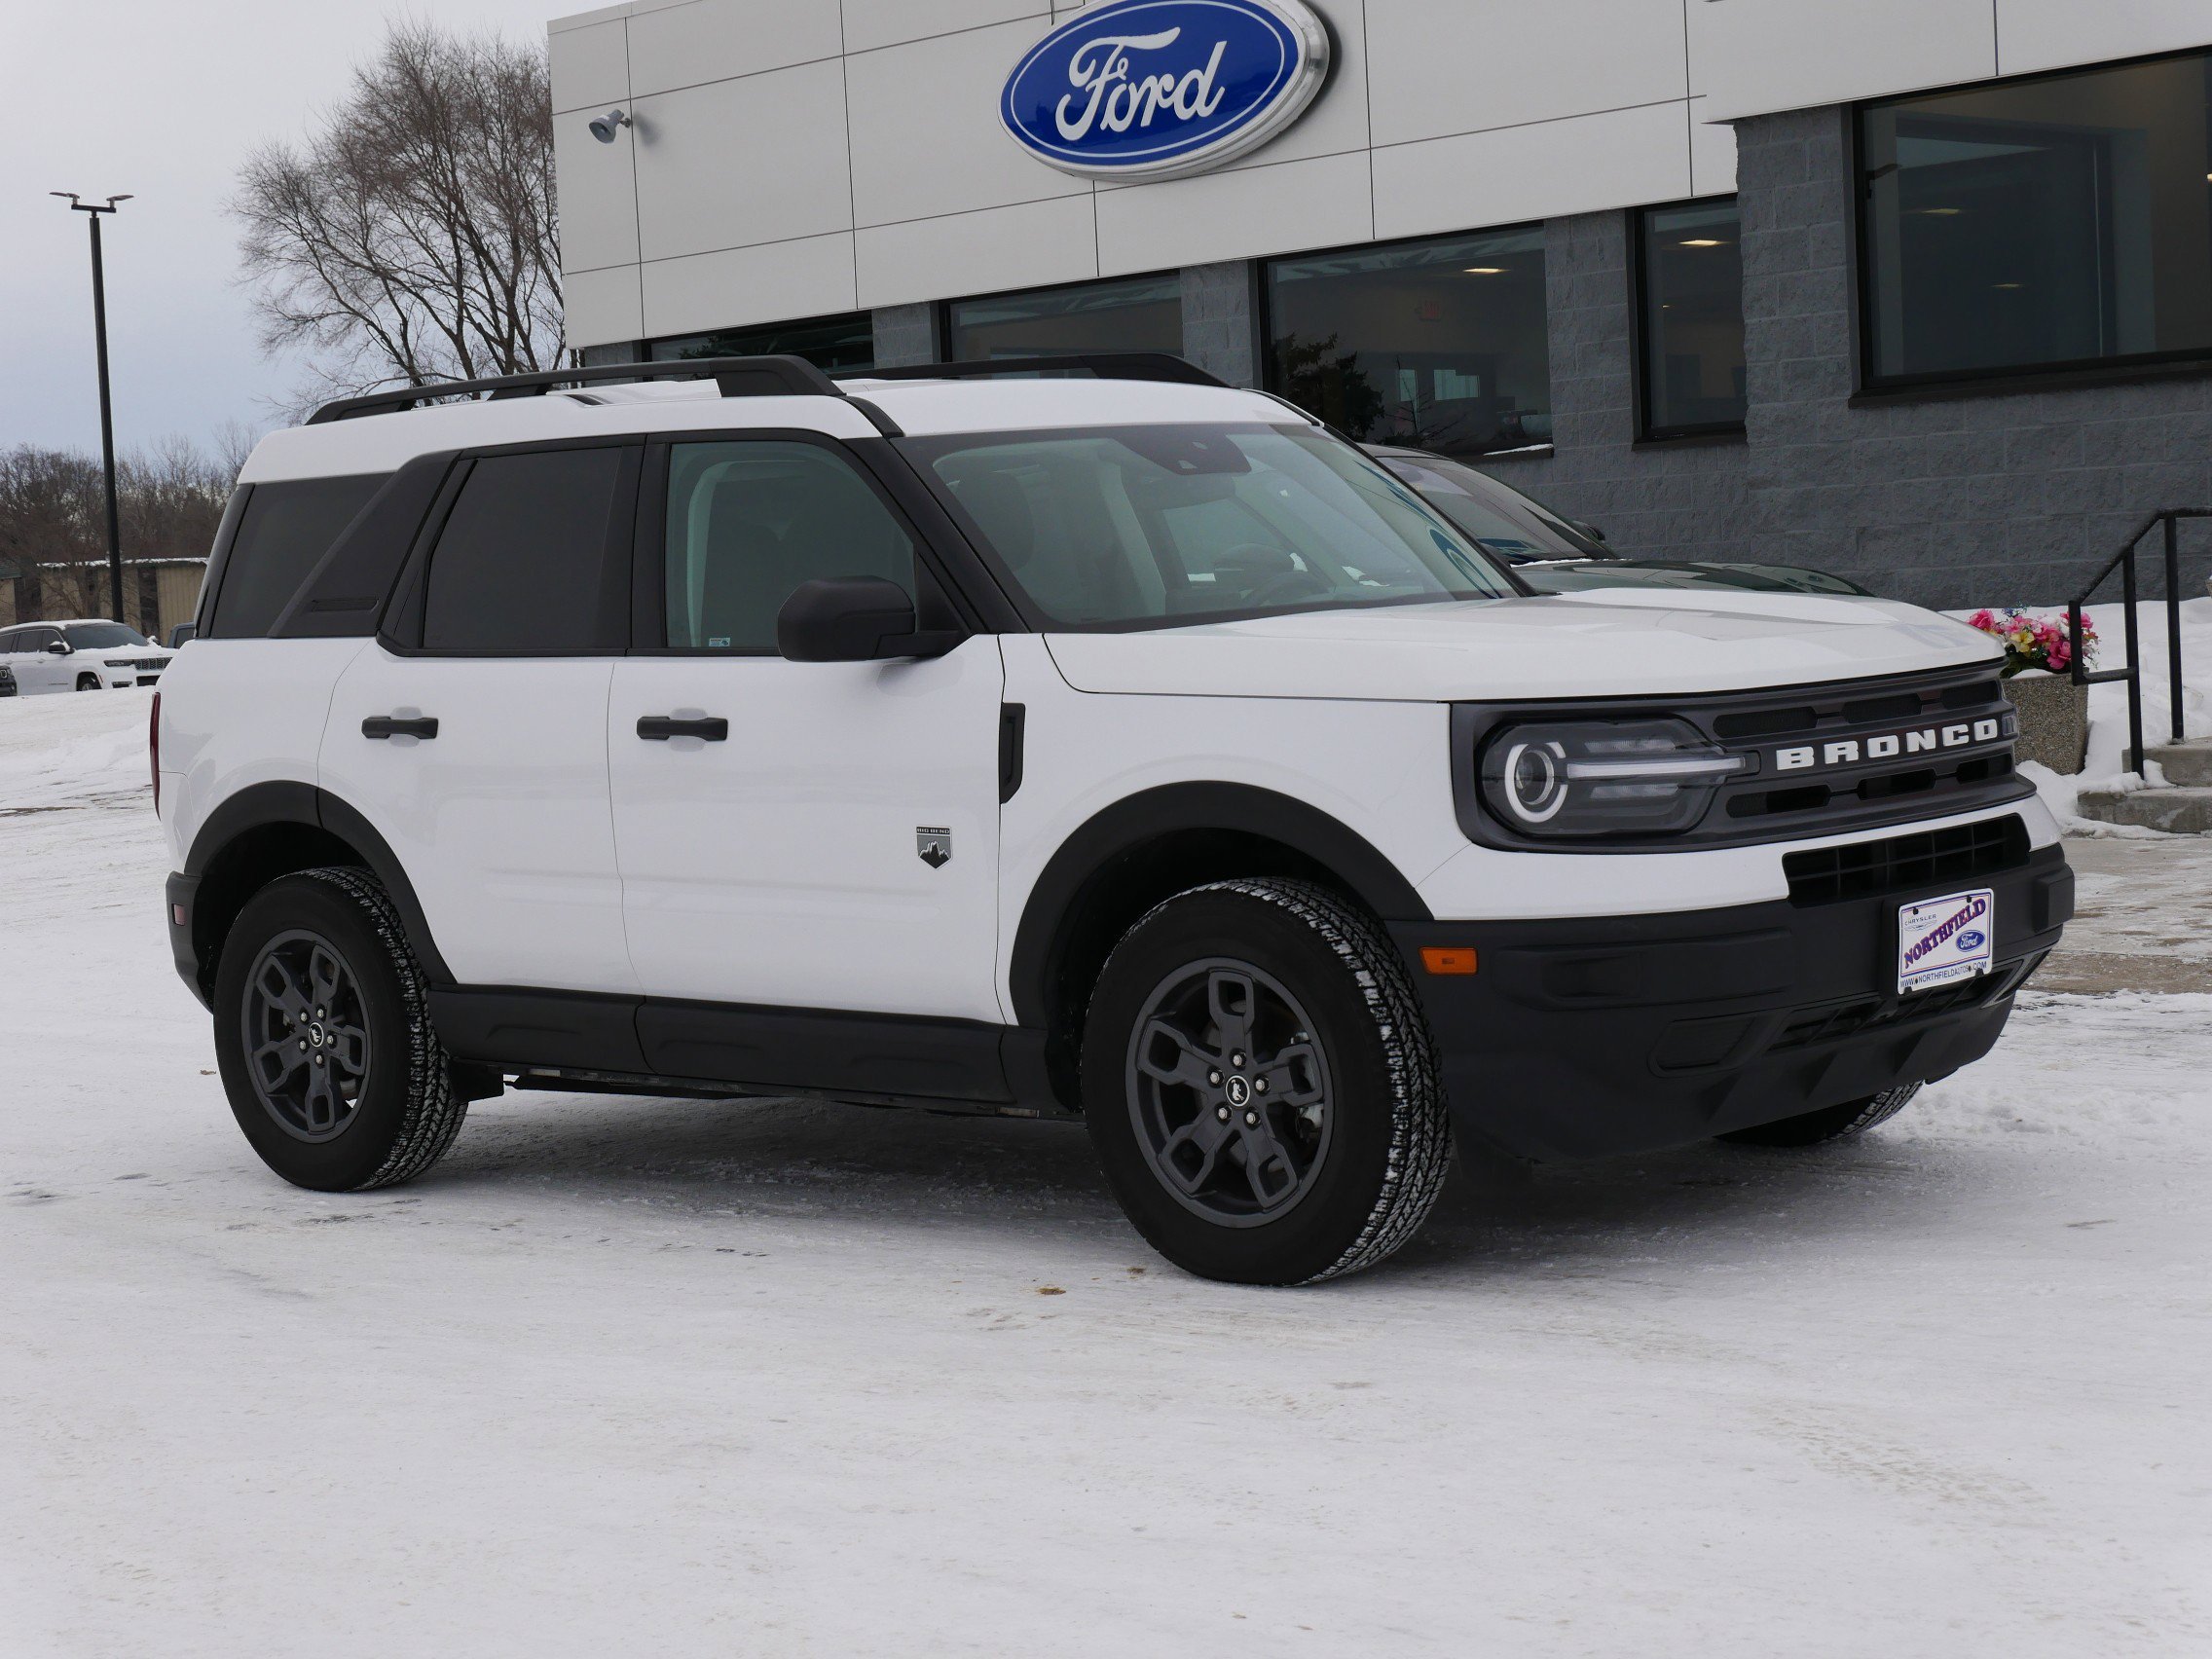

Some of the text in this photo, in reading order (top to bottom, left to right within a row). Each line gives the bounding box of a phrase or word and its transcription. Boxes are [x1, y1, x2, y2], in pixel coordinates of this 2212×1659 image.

[1055, 26, 1227, 141] Ford
[1776, 719, 1998, 770] BRONCO
[1903, 899, 1986, 969] NORTHFIELD
[1904, 914, 1936, 926] CHRYSLER
[1960, 933, 1978, 948] Ford
